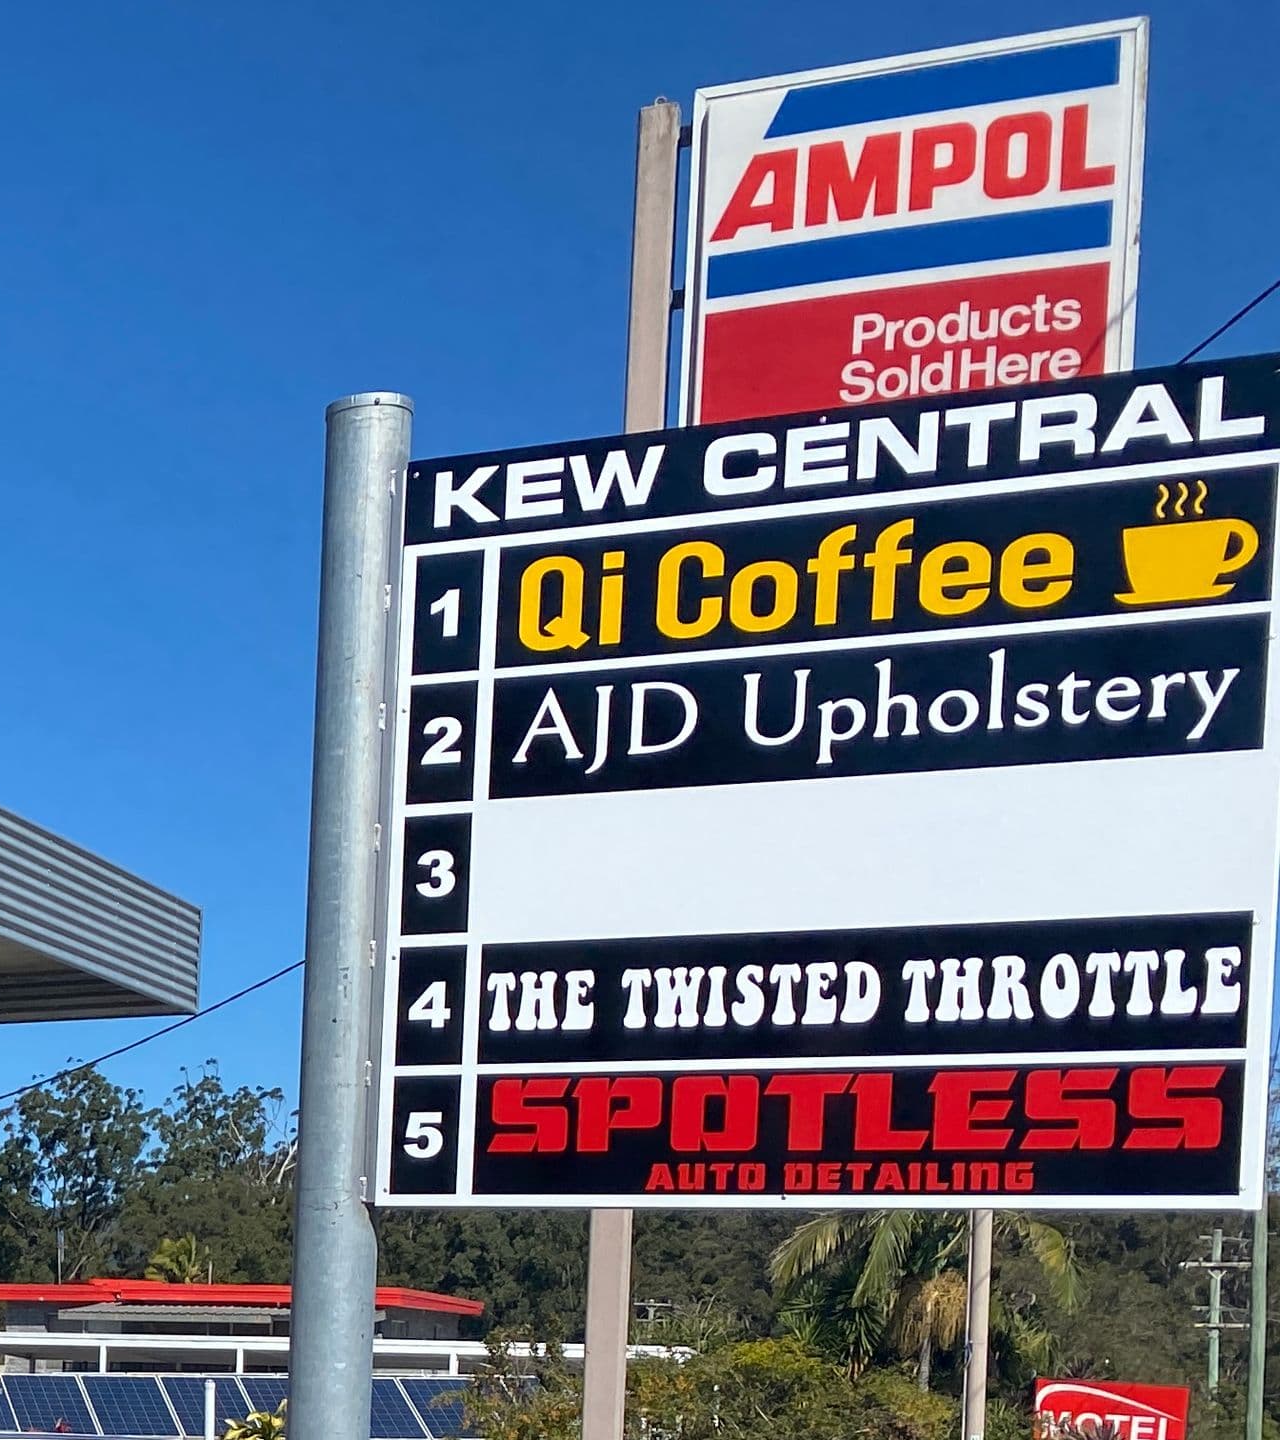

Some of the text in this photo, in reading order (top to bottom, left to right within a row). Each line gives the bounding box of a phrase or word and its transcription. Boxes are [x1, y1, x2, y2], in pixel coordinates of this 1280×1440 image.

[710, 104, 1115, 242] AMPOL
[851, 294, 1082, 355] Products
[839, 345, 1082, 403] Sold Here
[433, 376, 1266, 528] KEW CENTRAL
[429, 518, 1075, 652] 1 Qi Coffee
[420, 647, 1241, 775] 2 AJD Upholstery
[414, 849, 458, 899] 3
[407, 945, 1243, 1032] 4 THE TWISTED THROTTLE
[402, 1066, 1226, 1159] 5 SPOTLESS
[644, 1161, 1035, 1192] AUTO DETAILING
